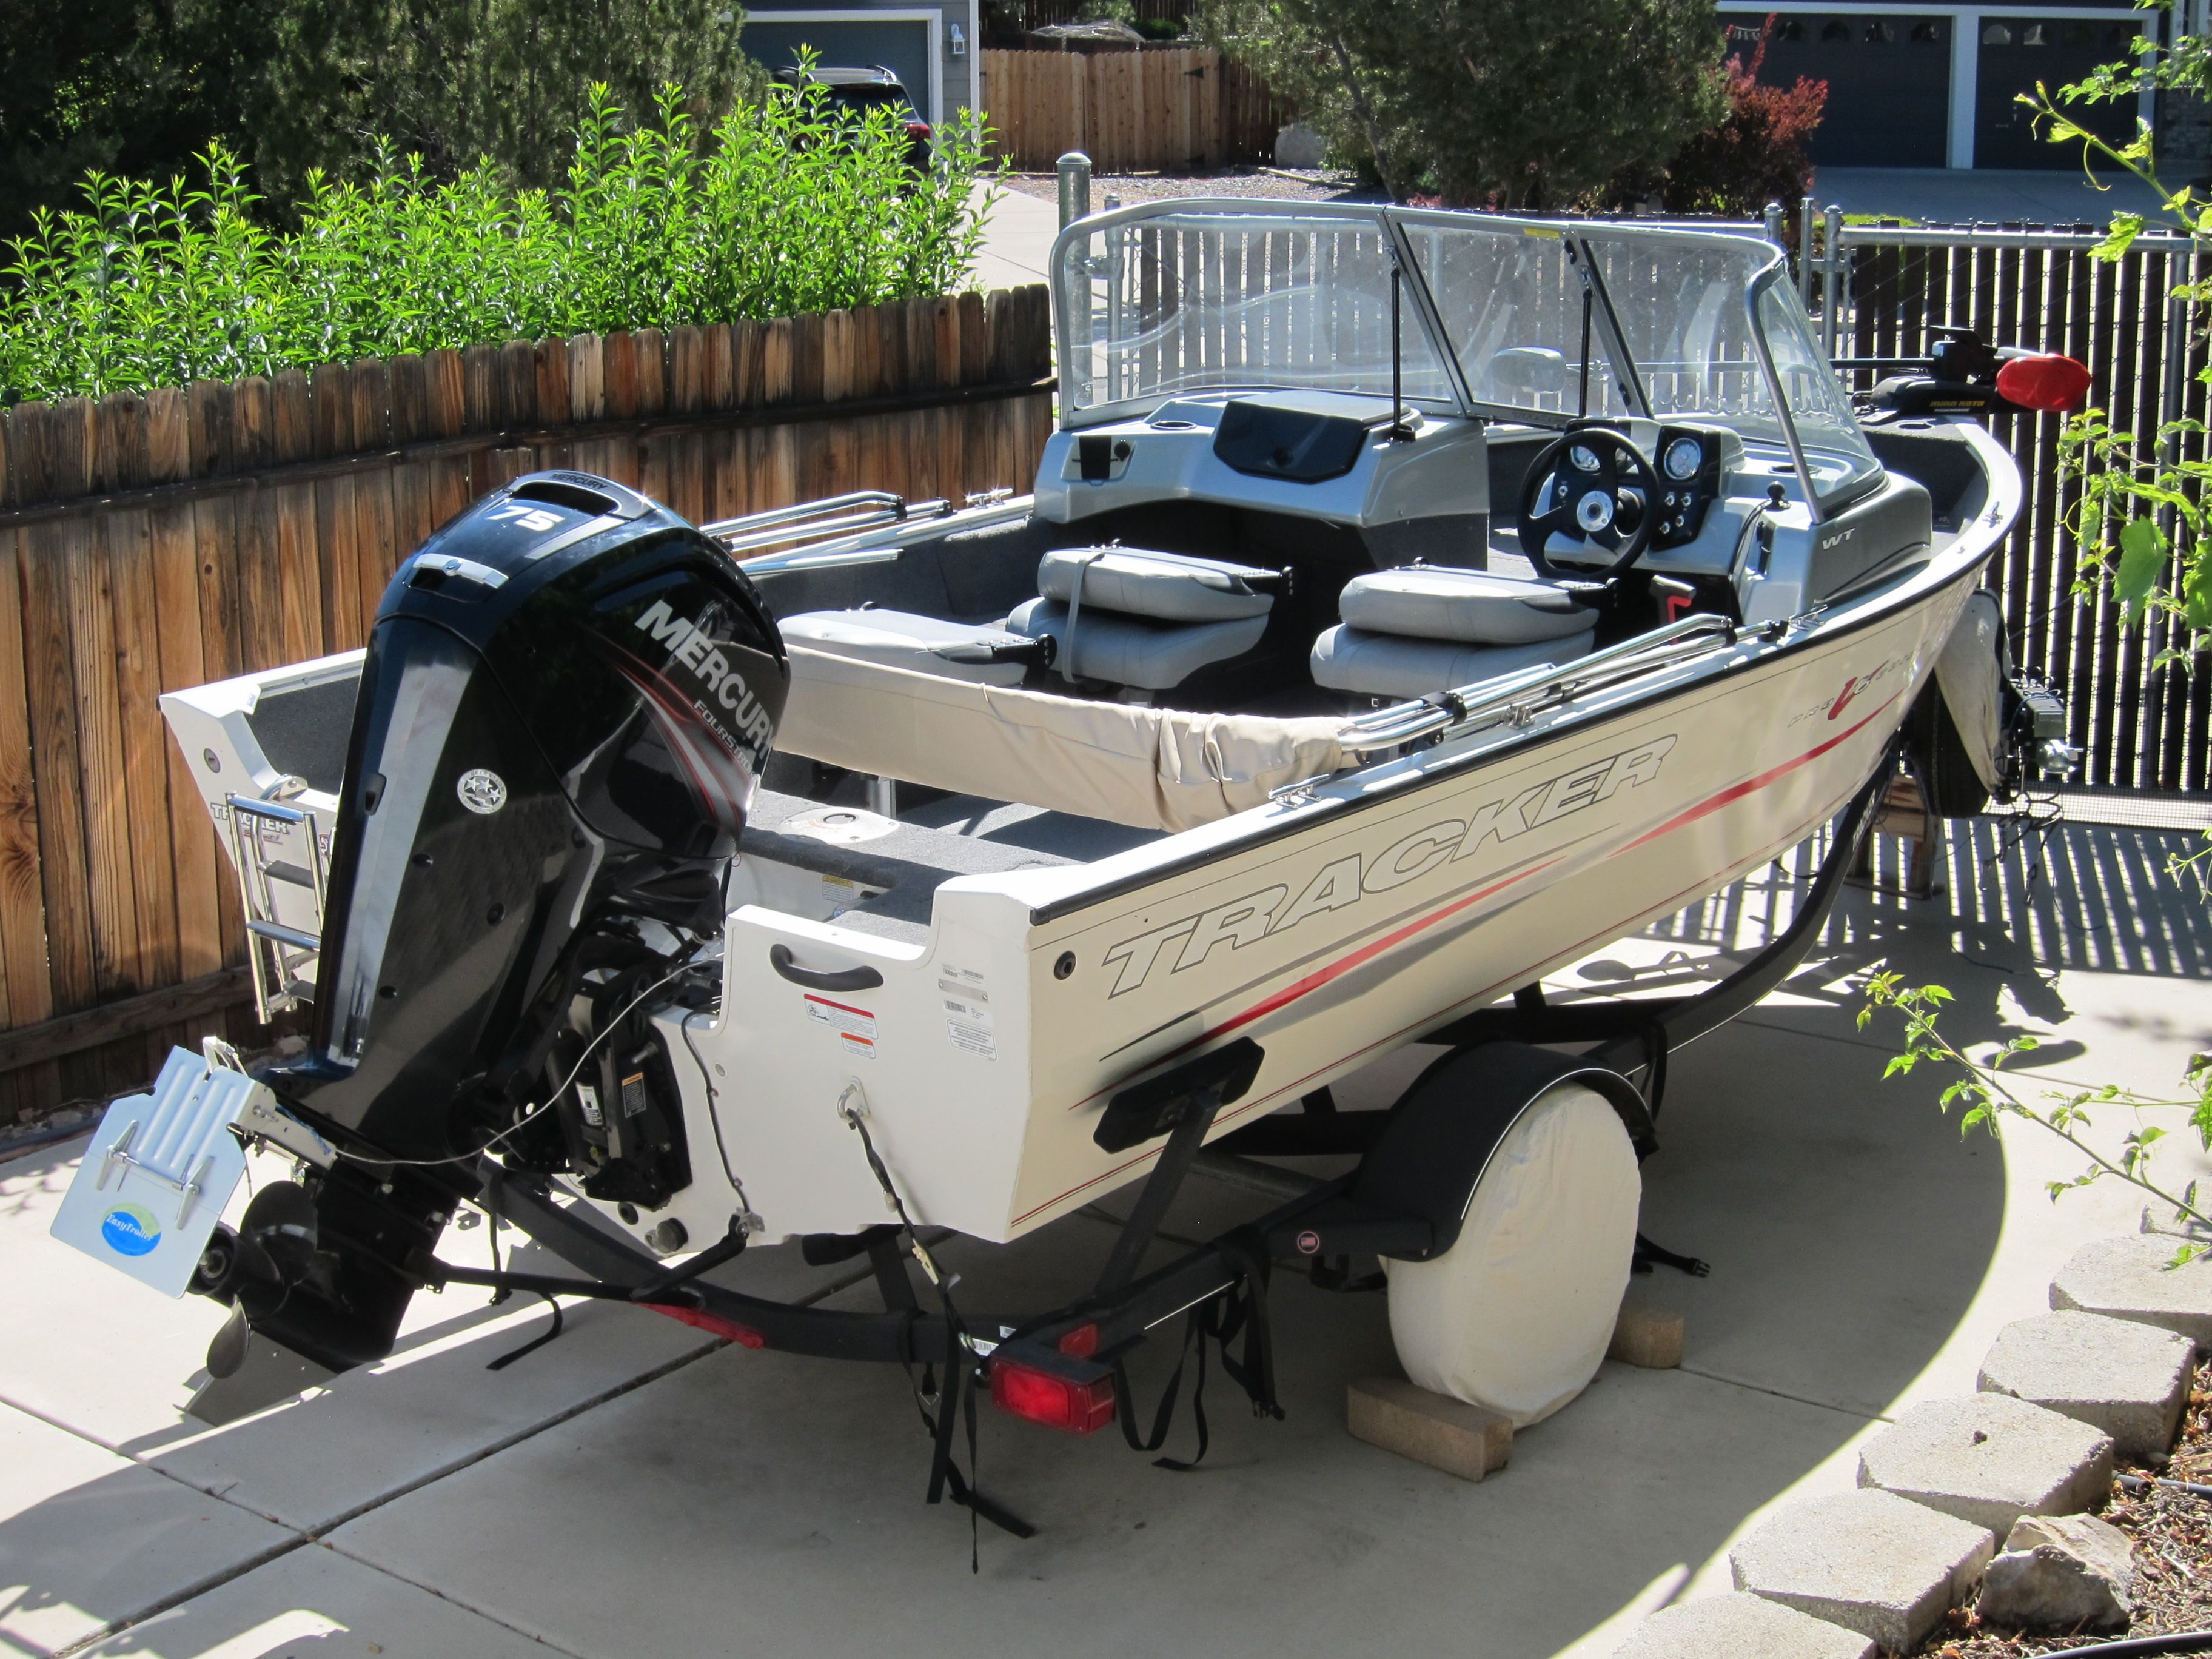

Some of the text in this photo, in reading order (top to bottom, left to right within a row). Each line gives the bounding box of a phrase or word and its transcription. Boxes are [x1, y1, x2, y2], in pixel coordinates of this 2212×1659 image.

[549, 474, 608, 489] MERCURY
[484, 505, 566, 531] 75
[1823, 528, 1855, 550] WT
[1101, 734, 1678, 999] TRACKER
[106, 1213, 154, 1241] EasyTroller
